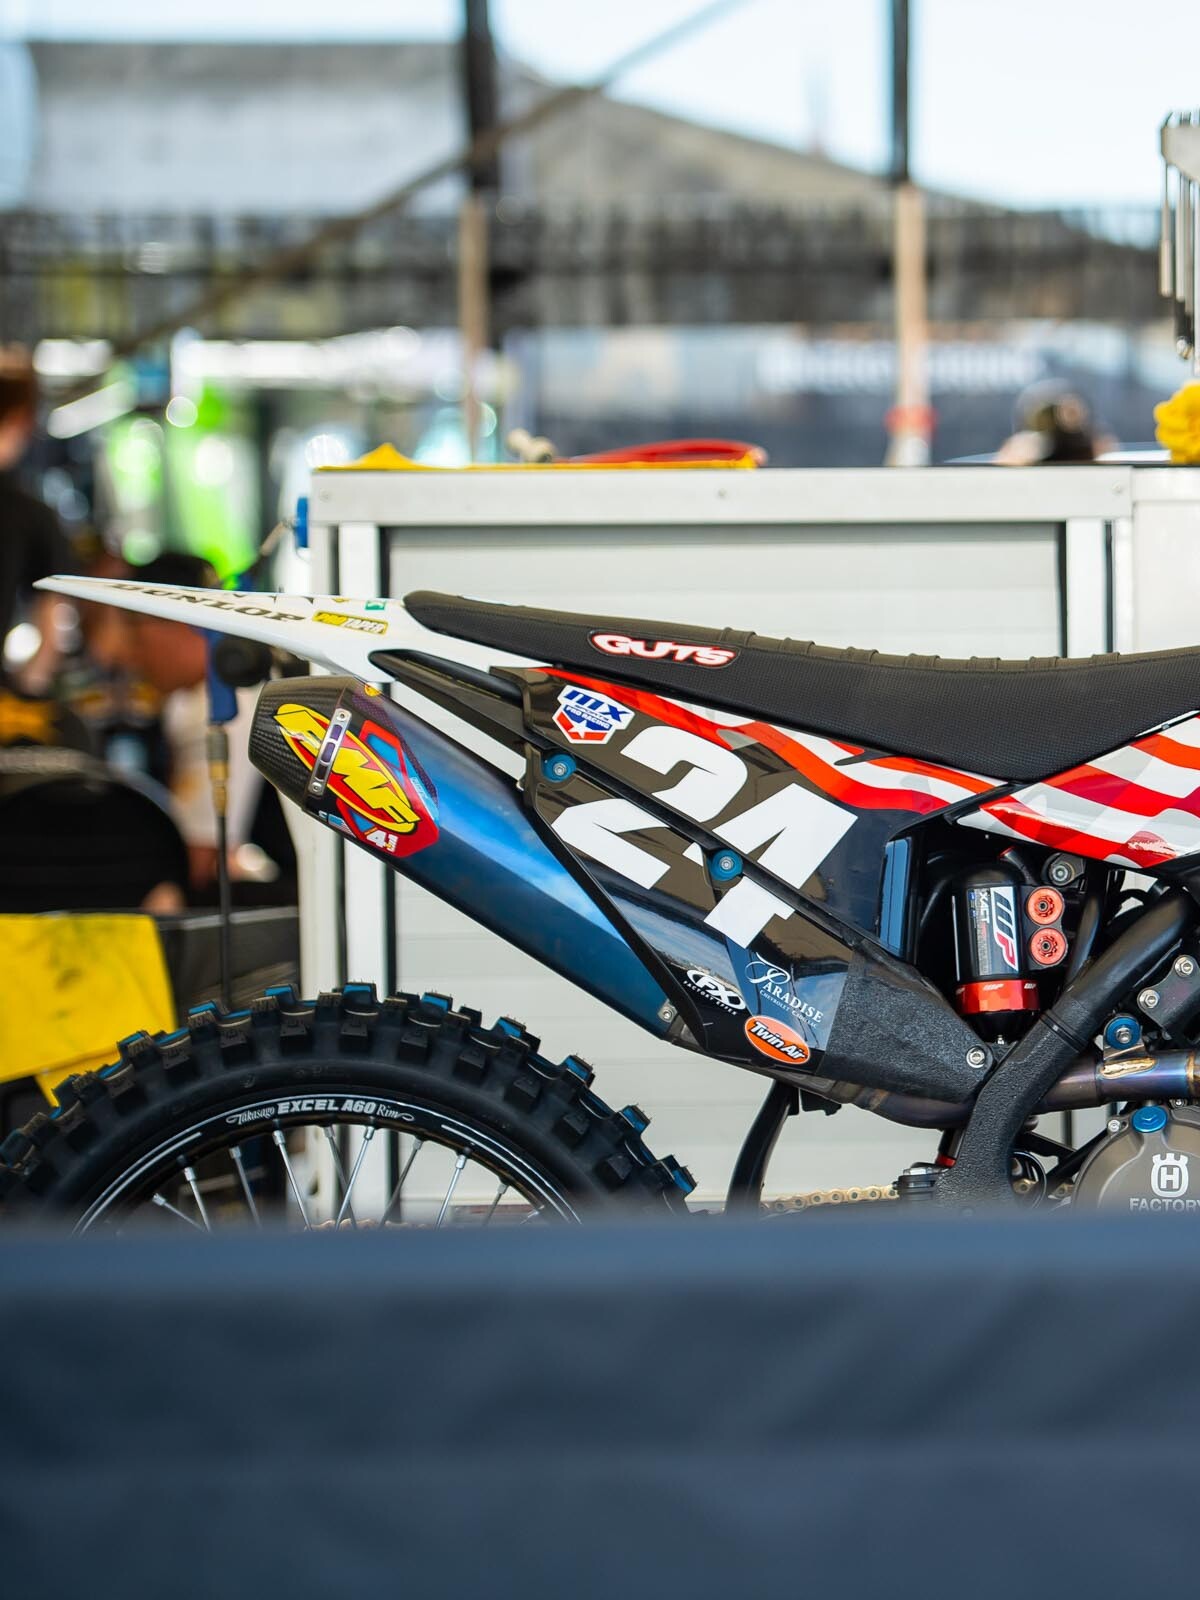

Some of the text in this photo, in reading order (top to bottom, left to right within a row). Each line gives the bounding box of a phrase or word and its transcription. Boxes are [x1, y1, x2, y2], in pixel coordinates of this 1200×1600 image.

[111, 583, 305, 621] DUNLOP
[591, 634, 735, 666] GUTS
[273, 710, 421, 824] FMF
[550, 726, 858, 949] 24
[683, 980, 738, 1016] FACTORY EFFEX
[750, 1021, 806, 1059] Twin Air
[229, 1099, 405, 1125] Takasago EXCEL A60 Rim
